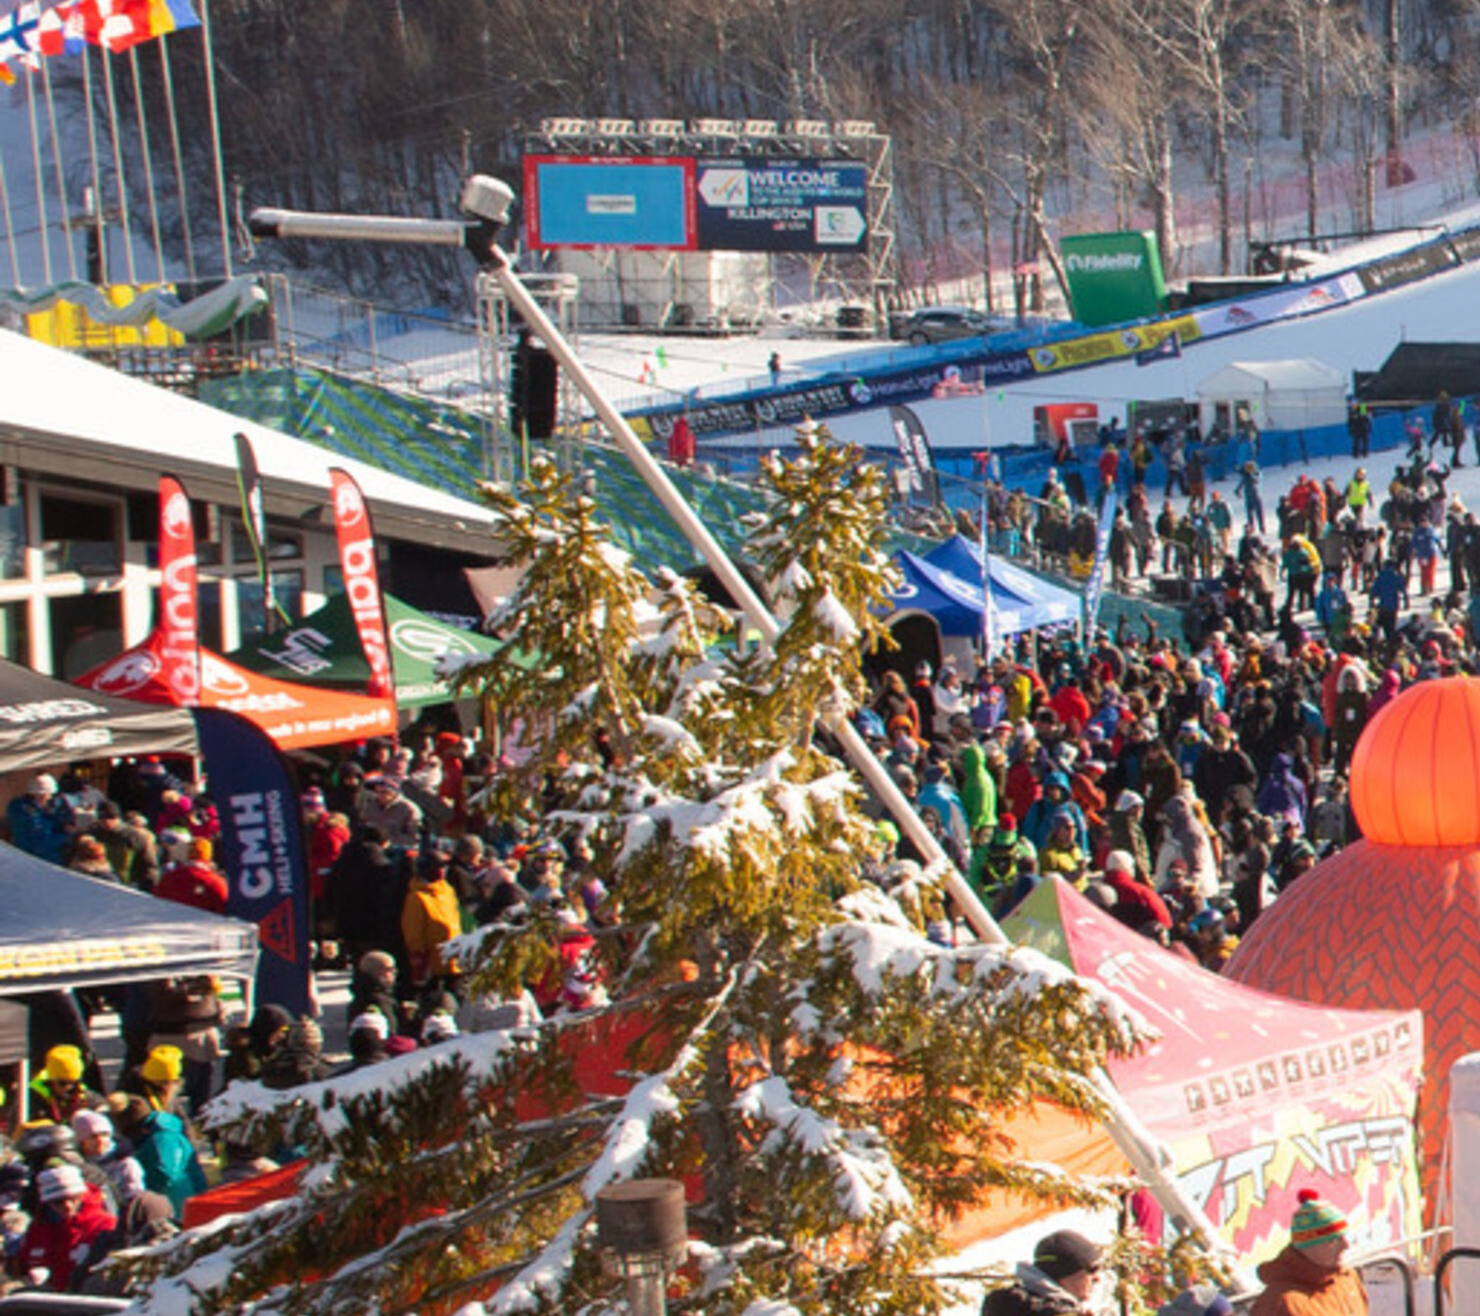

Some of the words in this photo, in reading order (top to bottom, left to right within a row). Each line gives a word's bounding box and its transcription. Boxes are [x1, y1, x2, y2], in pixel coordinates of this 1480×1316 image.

[751, 172, 841, 186] WELCOME
[727, 208, 812, 220] KILLINGTON
[1084, 253, 1143, 272] Fidelity
[229, 790, 273, 899] CMH
[1290, 1115, 1410, 1179] VIPER
